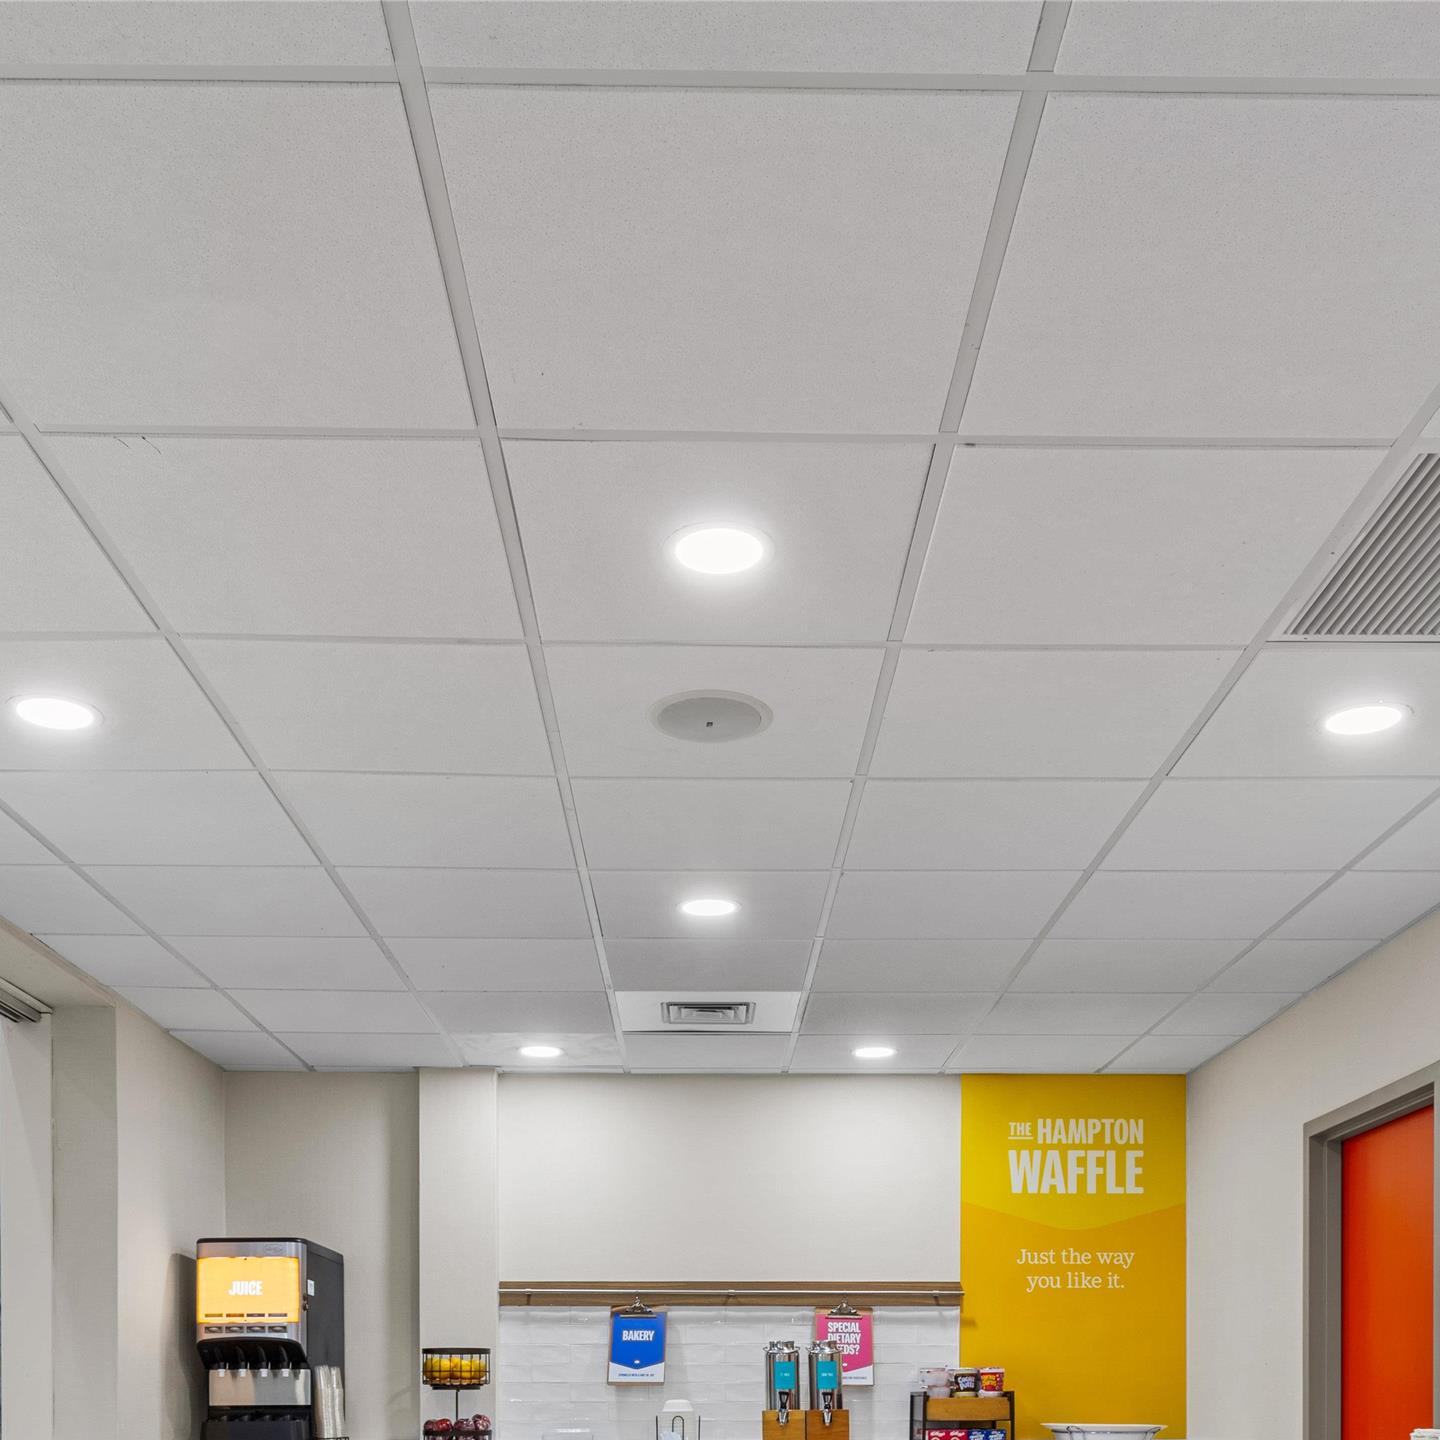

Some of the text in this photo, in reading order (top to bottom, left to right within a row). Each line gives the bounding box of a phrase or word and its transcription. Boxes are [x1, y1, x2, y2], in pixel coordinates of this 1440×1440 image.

[1008, 1118, 1144, 1145] THE HAMPTON
[1007, 1149, 1145, 1194] WAFFLE
[1016, 1248, 1135, 1270] Just the way
[228, 1280, 263, 1296] JUICE
[1026, 1271, 1125, 1293] you like it.
[622, 1330, 655, 1341] BAKERY
[827, 1321, 861, 1333] SPECIAL
[827, 1333, 861, 1344] DIETARY
